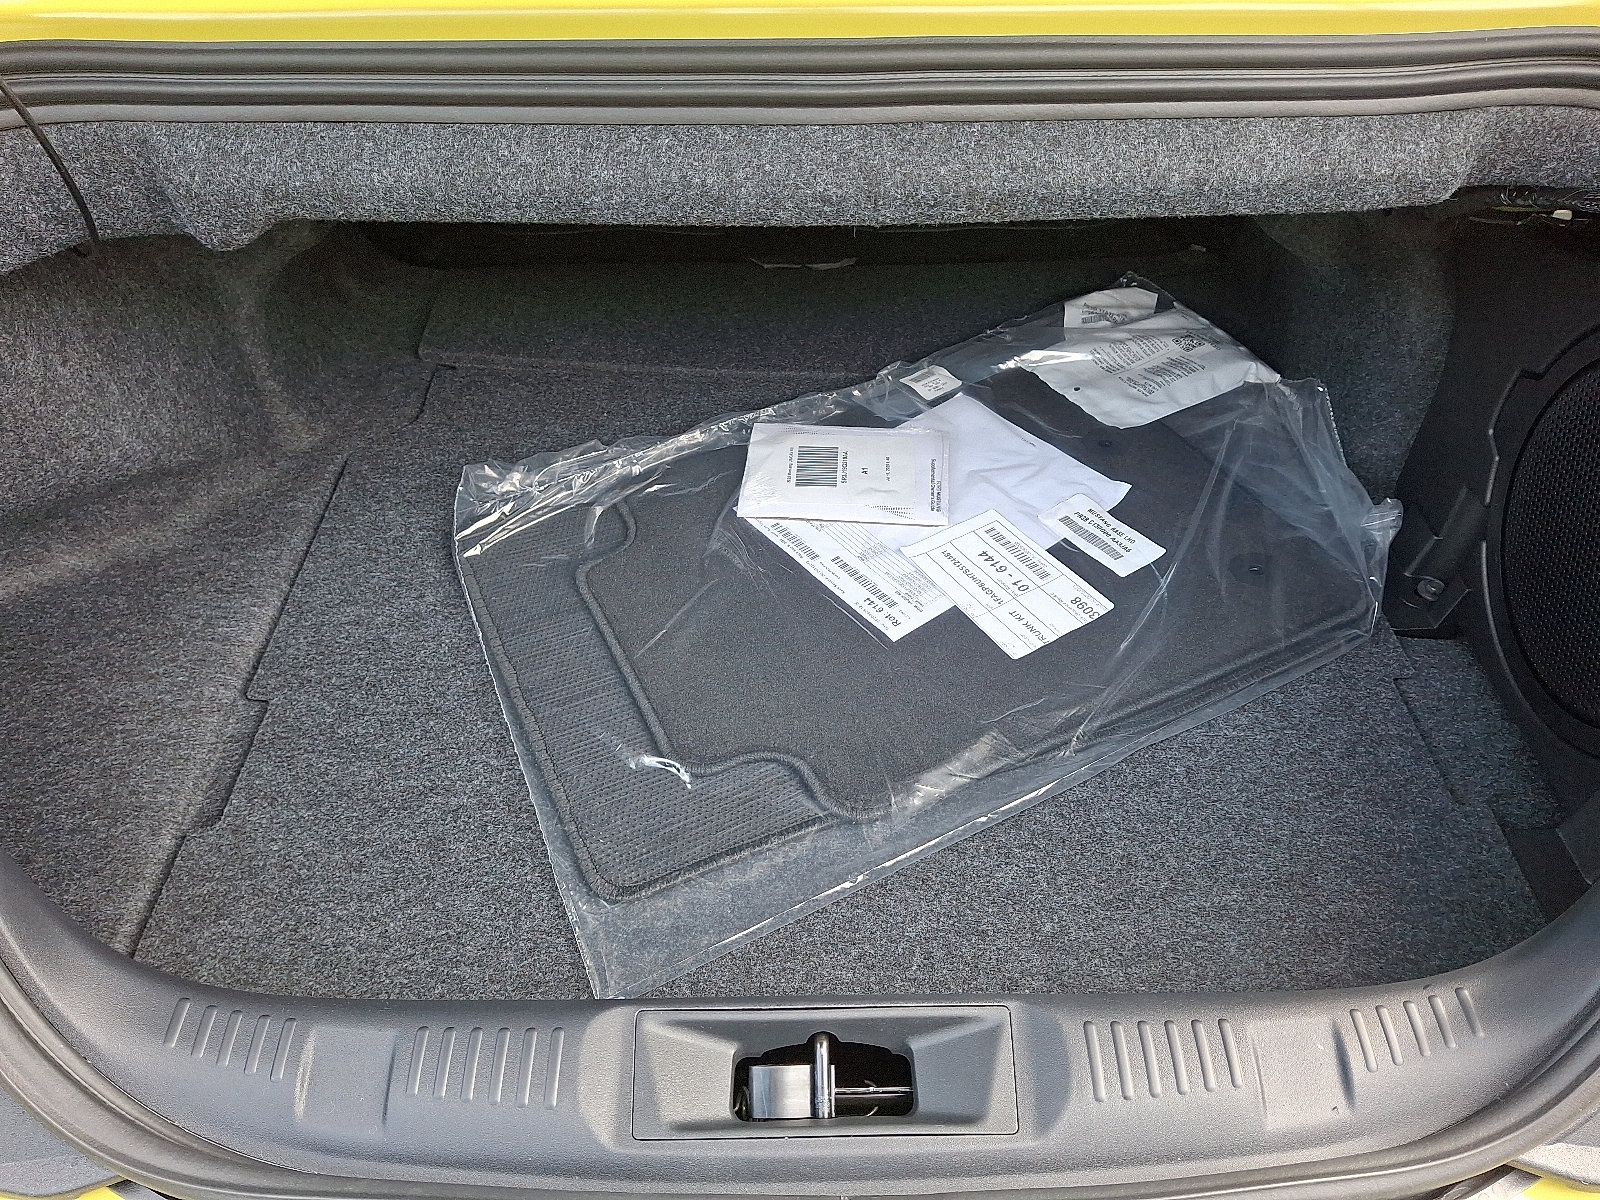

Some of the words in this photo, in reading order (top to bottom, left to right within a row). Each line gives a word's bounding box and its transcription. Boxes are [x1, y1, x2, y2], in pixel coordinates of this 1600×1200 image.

[861, 467, 869, 475] A1
[1087, 507, 1112, 528] MUSTANG
[1110, 525, 1124, 537] BASE
[976, 549, 1008, 574] 6144
[1011, 578, 1031, 593] 01
[862, 596, 886, 613] 6144
[1069, 596, 1101, 620] 3098
[1007, 608, 1025, 622] KIT
[1020, 619, 1051, 645] TRUNK
